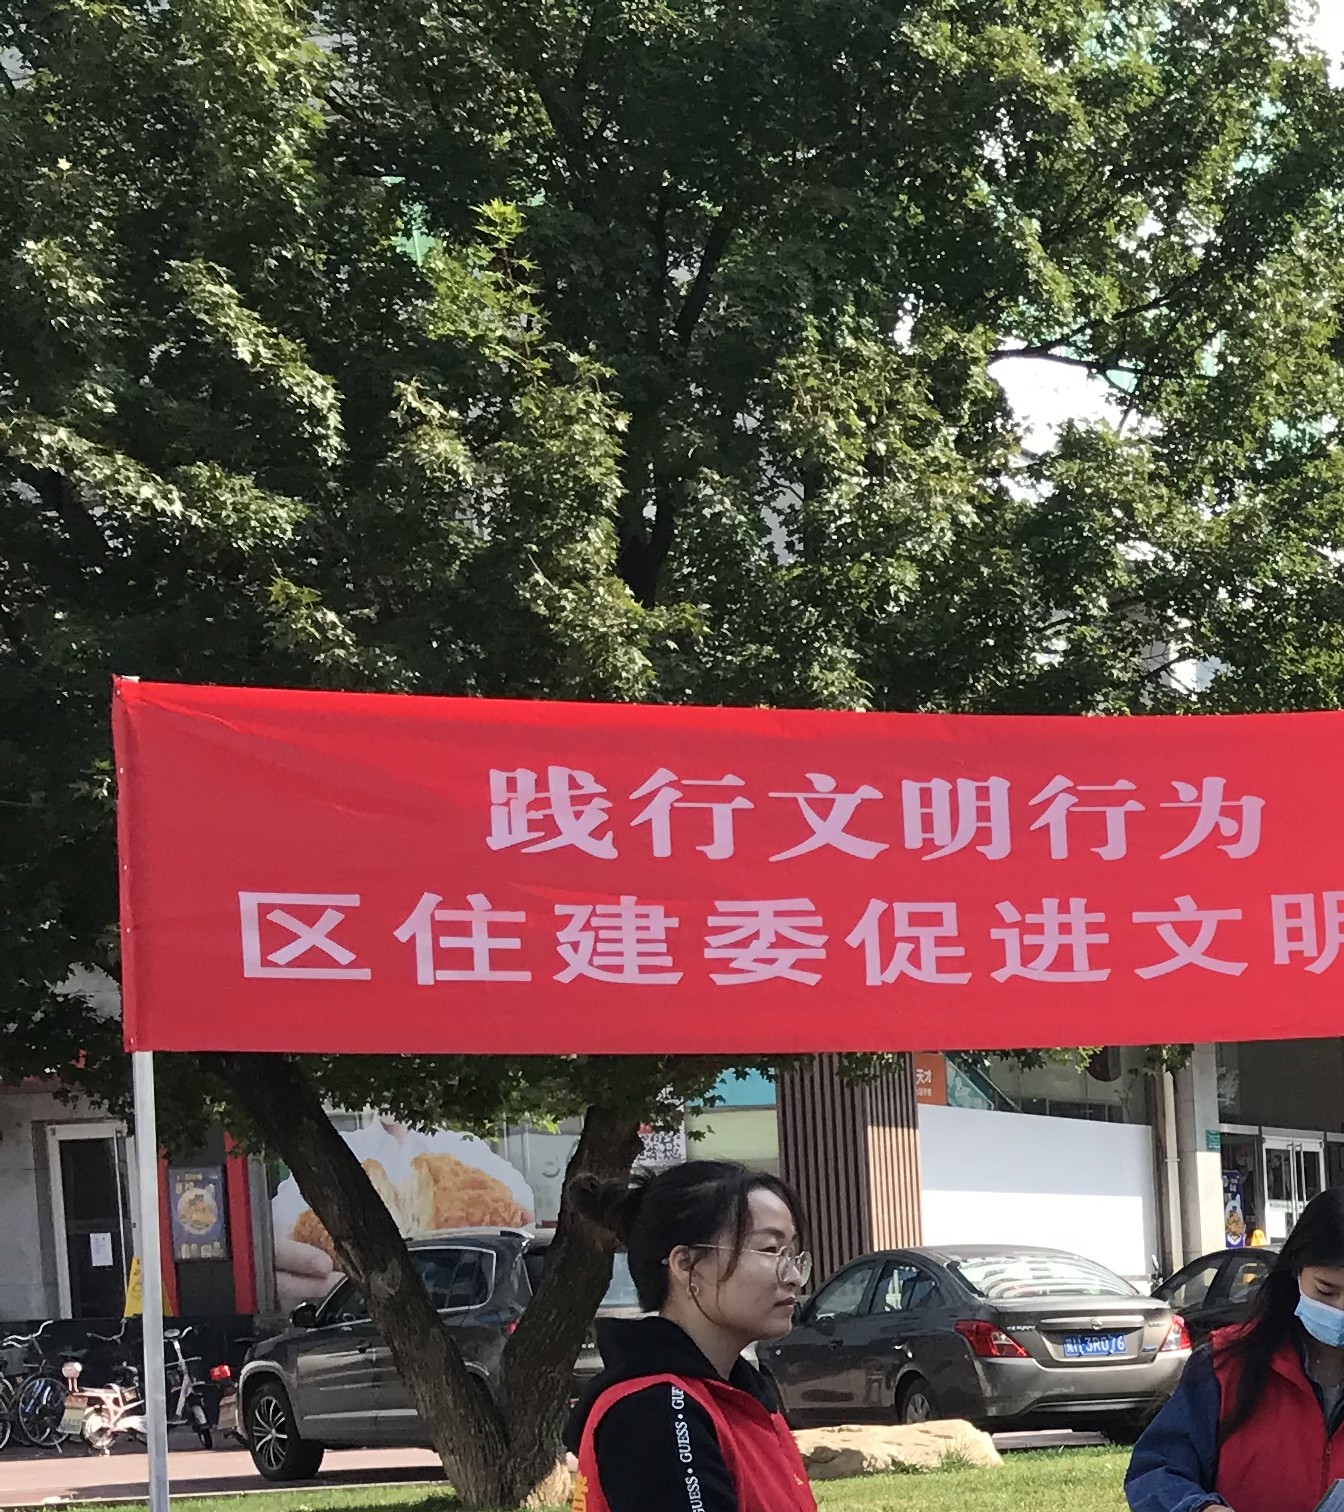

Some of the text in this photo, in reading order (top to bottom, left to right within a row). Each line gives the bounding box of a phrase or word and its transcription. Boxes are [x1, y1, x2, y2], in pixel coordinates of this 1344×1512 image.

[484, 764, 1266, 864] 践行文明行为
[671, 1386, 685, 1410] GUE
[676, 1421, 693, 1463] GUESS
